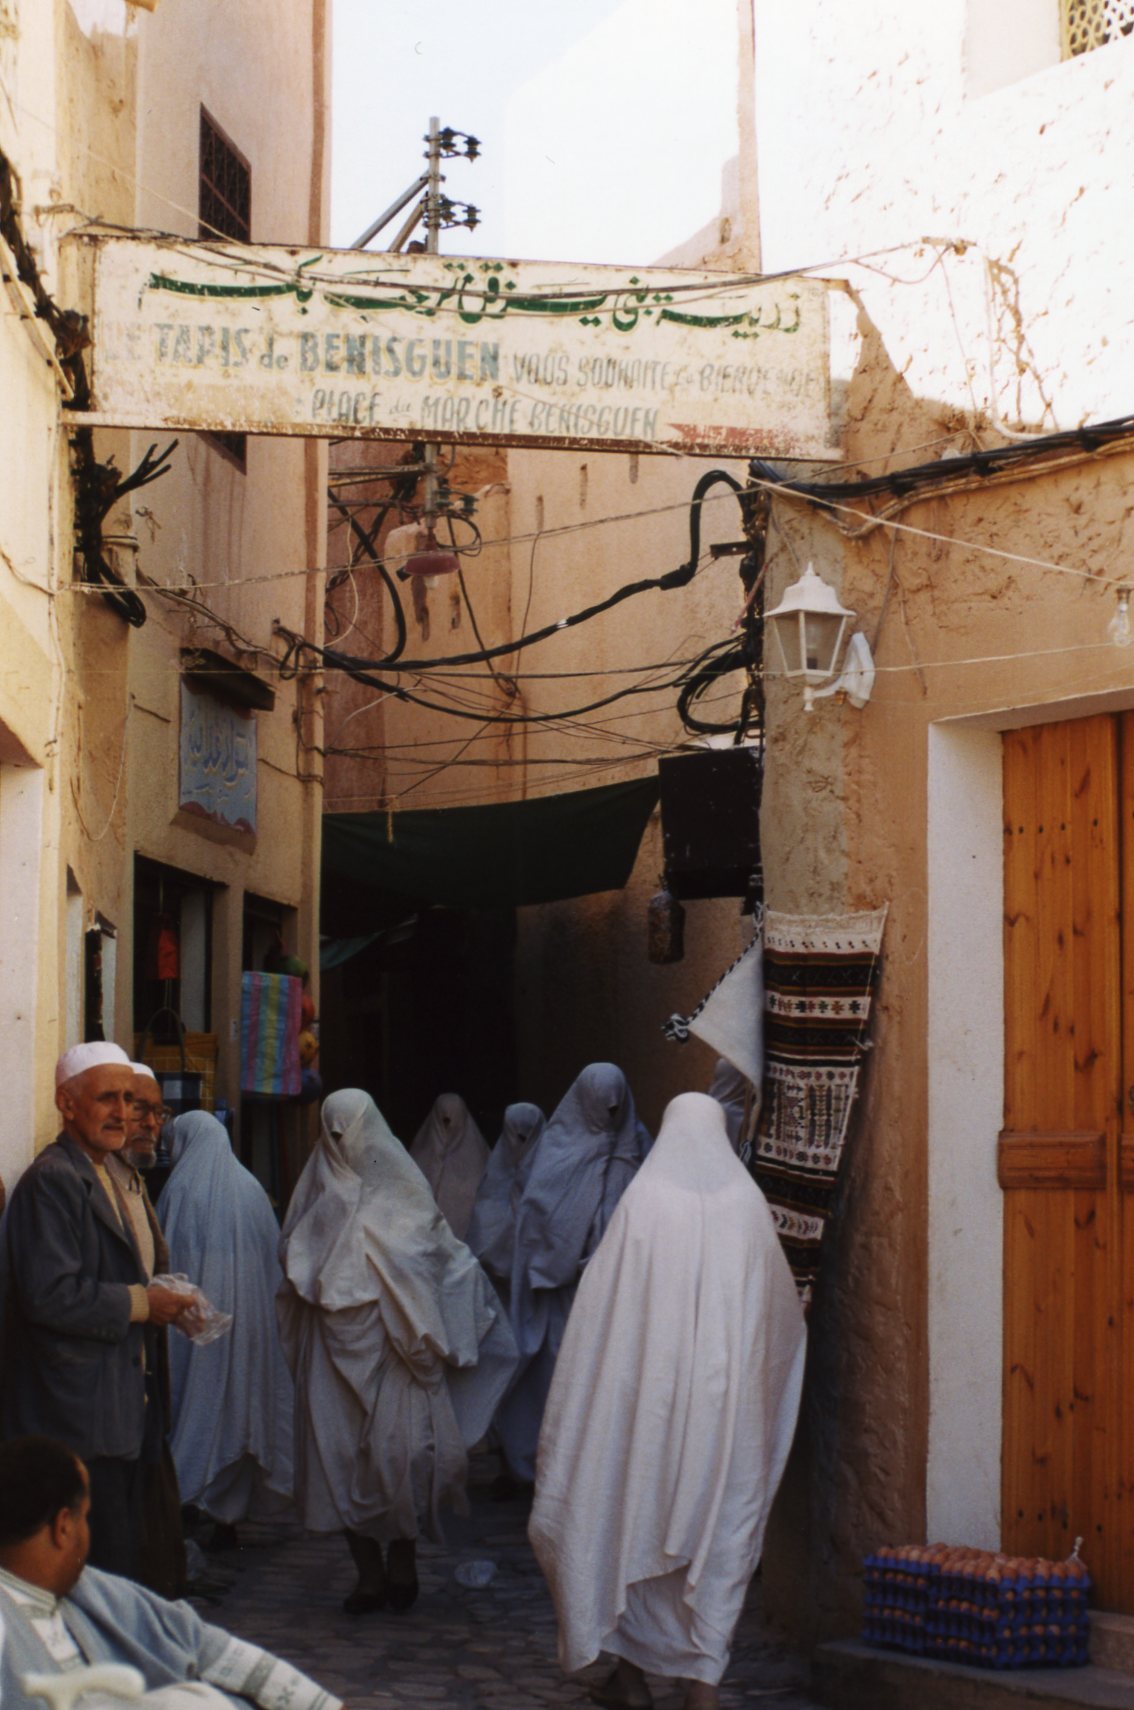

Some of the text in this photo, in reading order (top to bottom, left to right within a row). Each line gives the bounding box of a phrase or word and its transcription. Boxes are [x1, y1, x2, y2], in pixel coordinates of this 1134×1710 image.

[153, 322, 251, 369] TAPIS
[259, 332, 289, 370] de
[300, 332, 500, 382] BENISGUEN
[513, 352, 570, 387] VOUS
[576, 355, 672, 391] SOUHAITE
[311, 387, 661, 439] PLACE du MARCHE BENISGUEN
